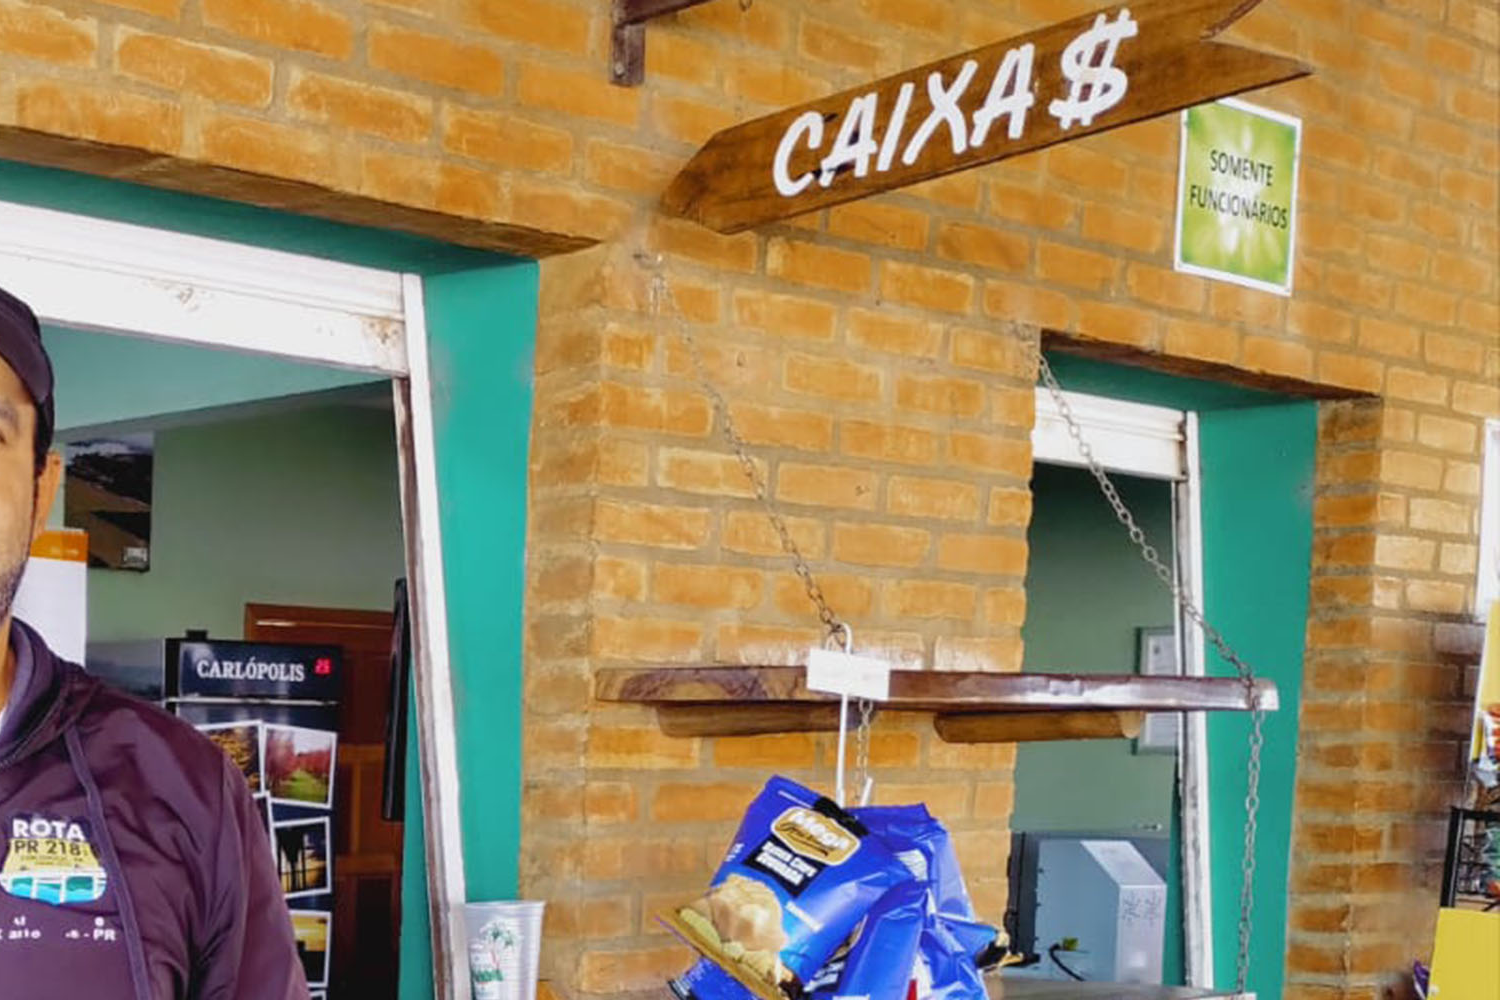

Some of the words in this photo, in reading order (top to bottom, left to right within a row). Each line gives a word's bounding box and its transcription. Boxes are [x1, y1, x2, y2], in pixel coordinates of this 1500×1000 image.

[773, 42, 1035, 197] CAIXA
[1209, 149, 1274, 187] SOMENTE
[196, 656, 305, 682] CARLÓPOLIS
[12, 818, 87, 842] ROTA
[14, 839, 39, 854] PR
[45, 840, 82, 857] 218
